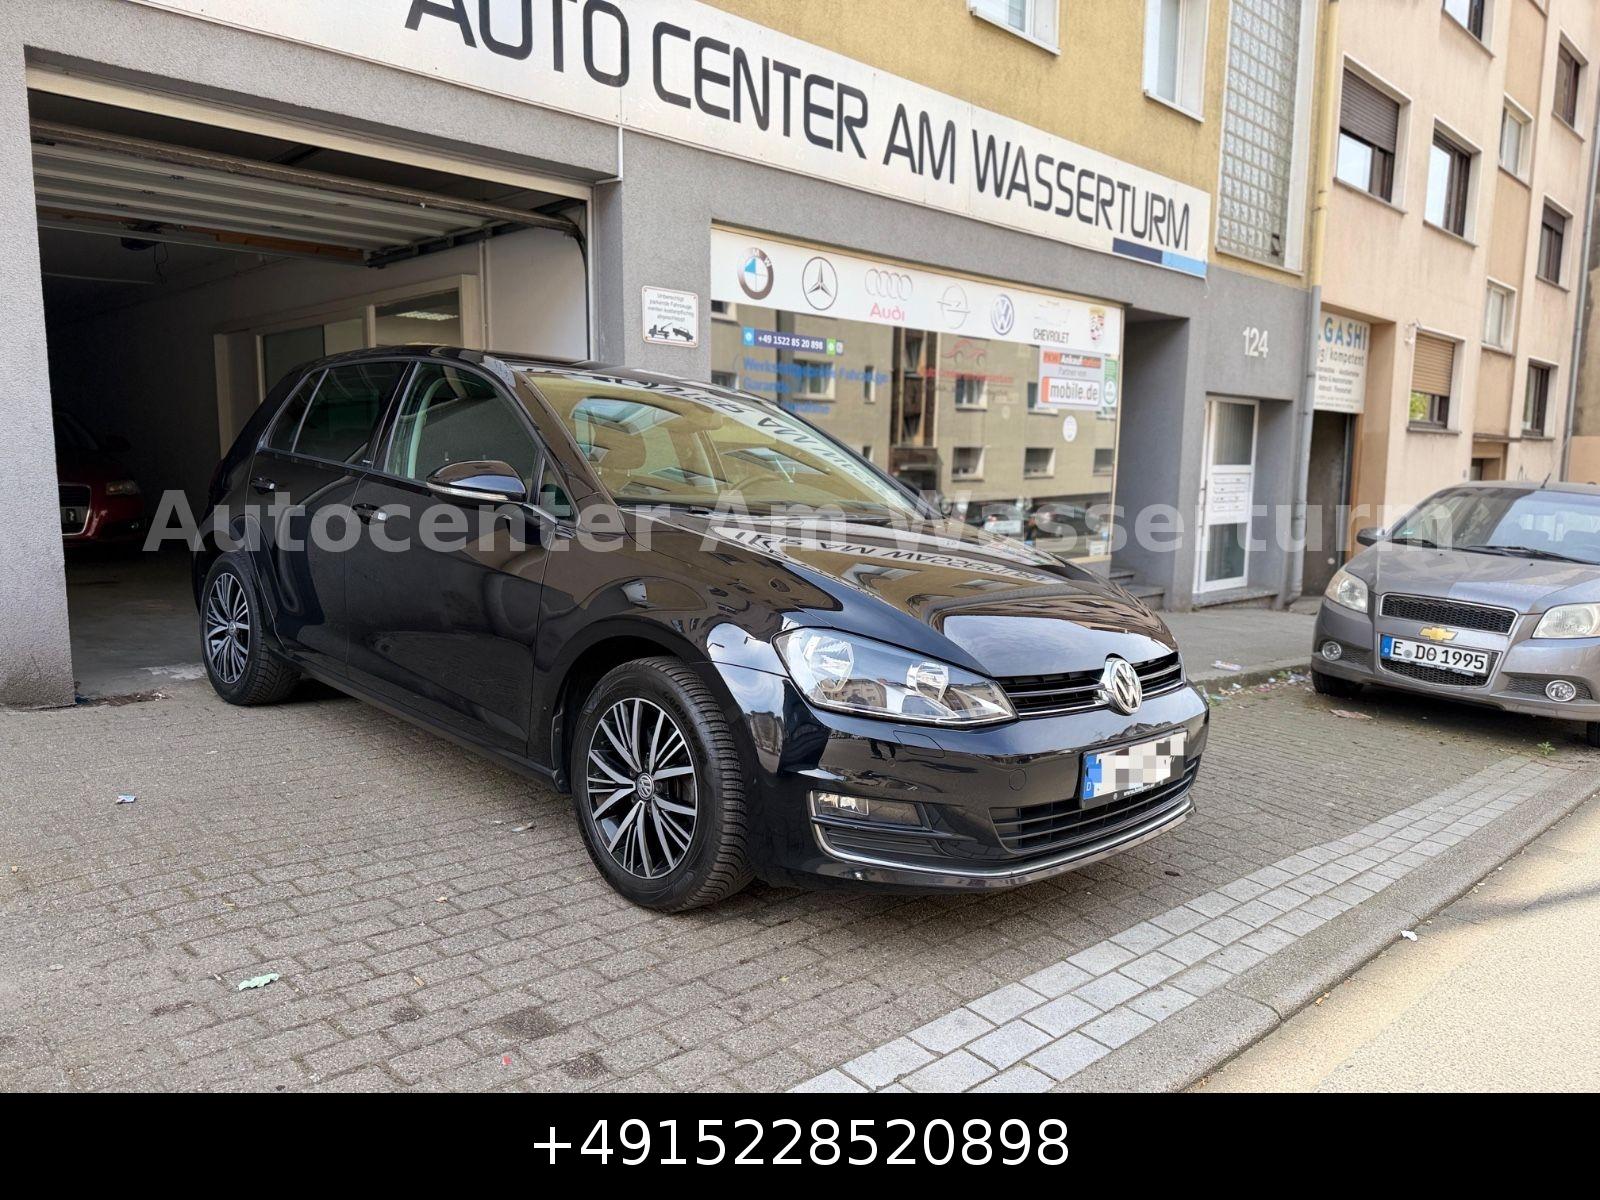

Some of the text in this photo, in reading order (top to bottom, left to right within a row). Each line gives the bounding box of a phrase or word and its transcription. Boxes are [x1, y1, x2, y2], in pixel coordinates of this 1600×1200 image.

[652, 21, 868, 160] CENTER
[882, 103, 956, 185] AM
[972, 128, 1190, 252] WASSERTURM
[870, 302, 906, 322] Audi
[773, 335, 790, 347] 1522
[791, 337, 800, 348] 85
[801, 338, 810, 349] 20
[810, 339, 824, 350] 898
[1033, 327, 1070, 345] CHEVROLET
[1242, 326, 1269, 359] 124
[1050, 381, 1099, 401] mobile.de
[1393, 641, 1404, 657] E
[1440, 649, 1486, 670] 1995
